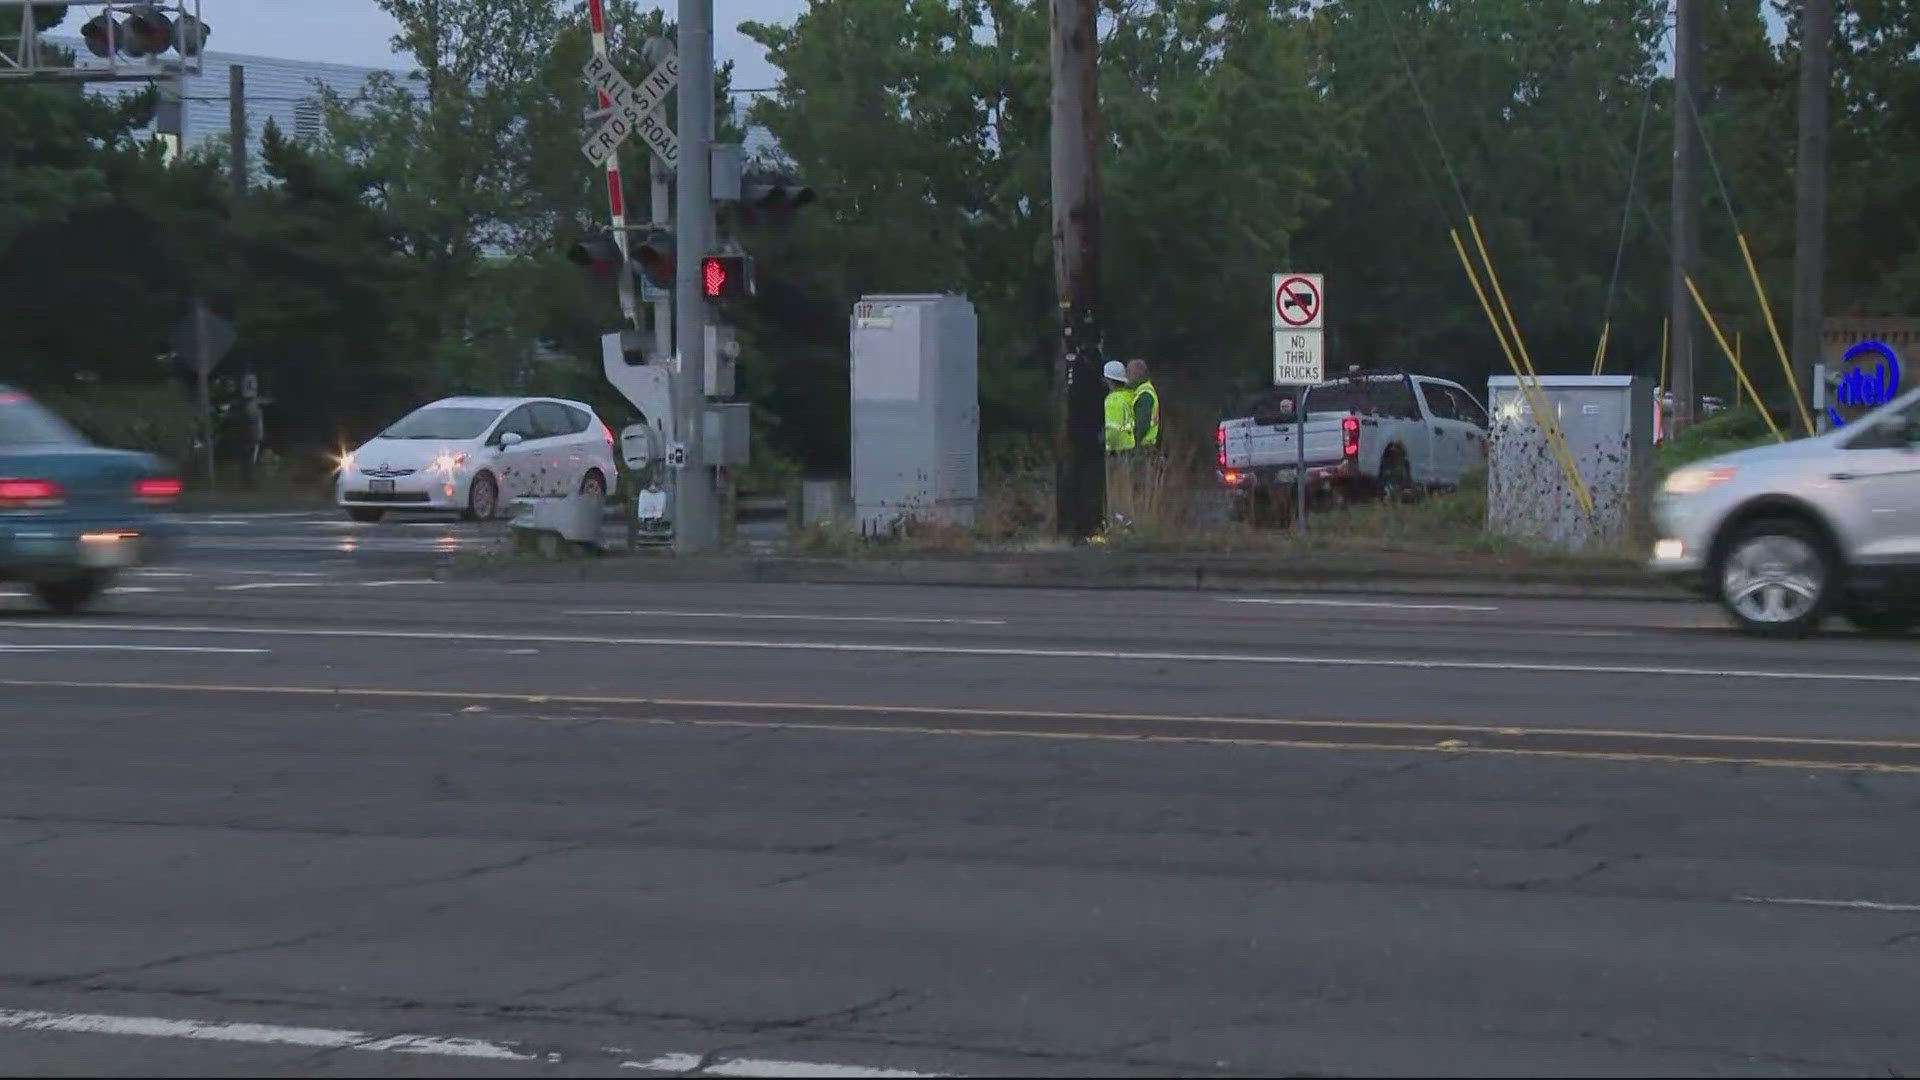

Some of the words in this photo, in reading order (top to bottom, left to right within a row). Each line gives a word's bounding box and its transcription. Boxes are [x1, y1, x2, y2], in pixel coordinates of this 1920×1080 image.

[588, 58, 626, 106] RAIL
[588, 60, 679, 161] CROSSING
[1291, 335, 1306, 349] NO
[1286, 350, 1312, 365] THRU
[1279, 365, 1319, 380] TRUCKS
